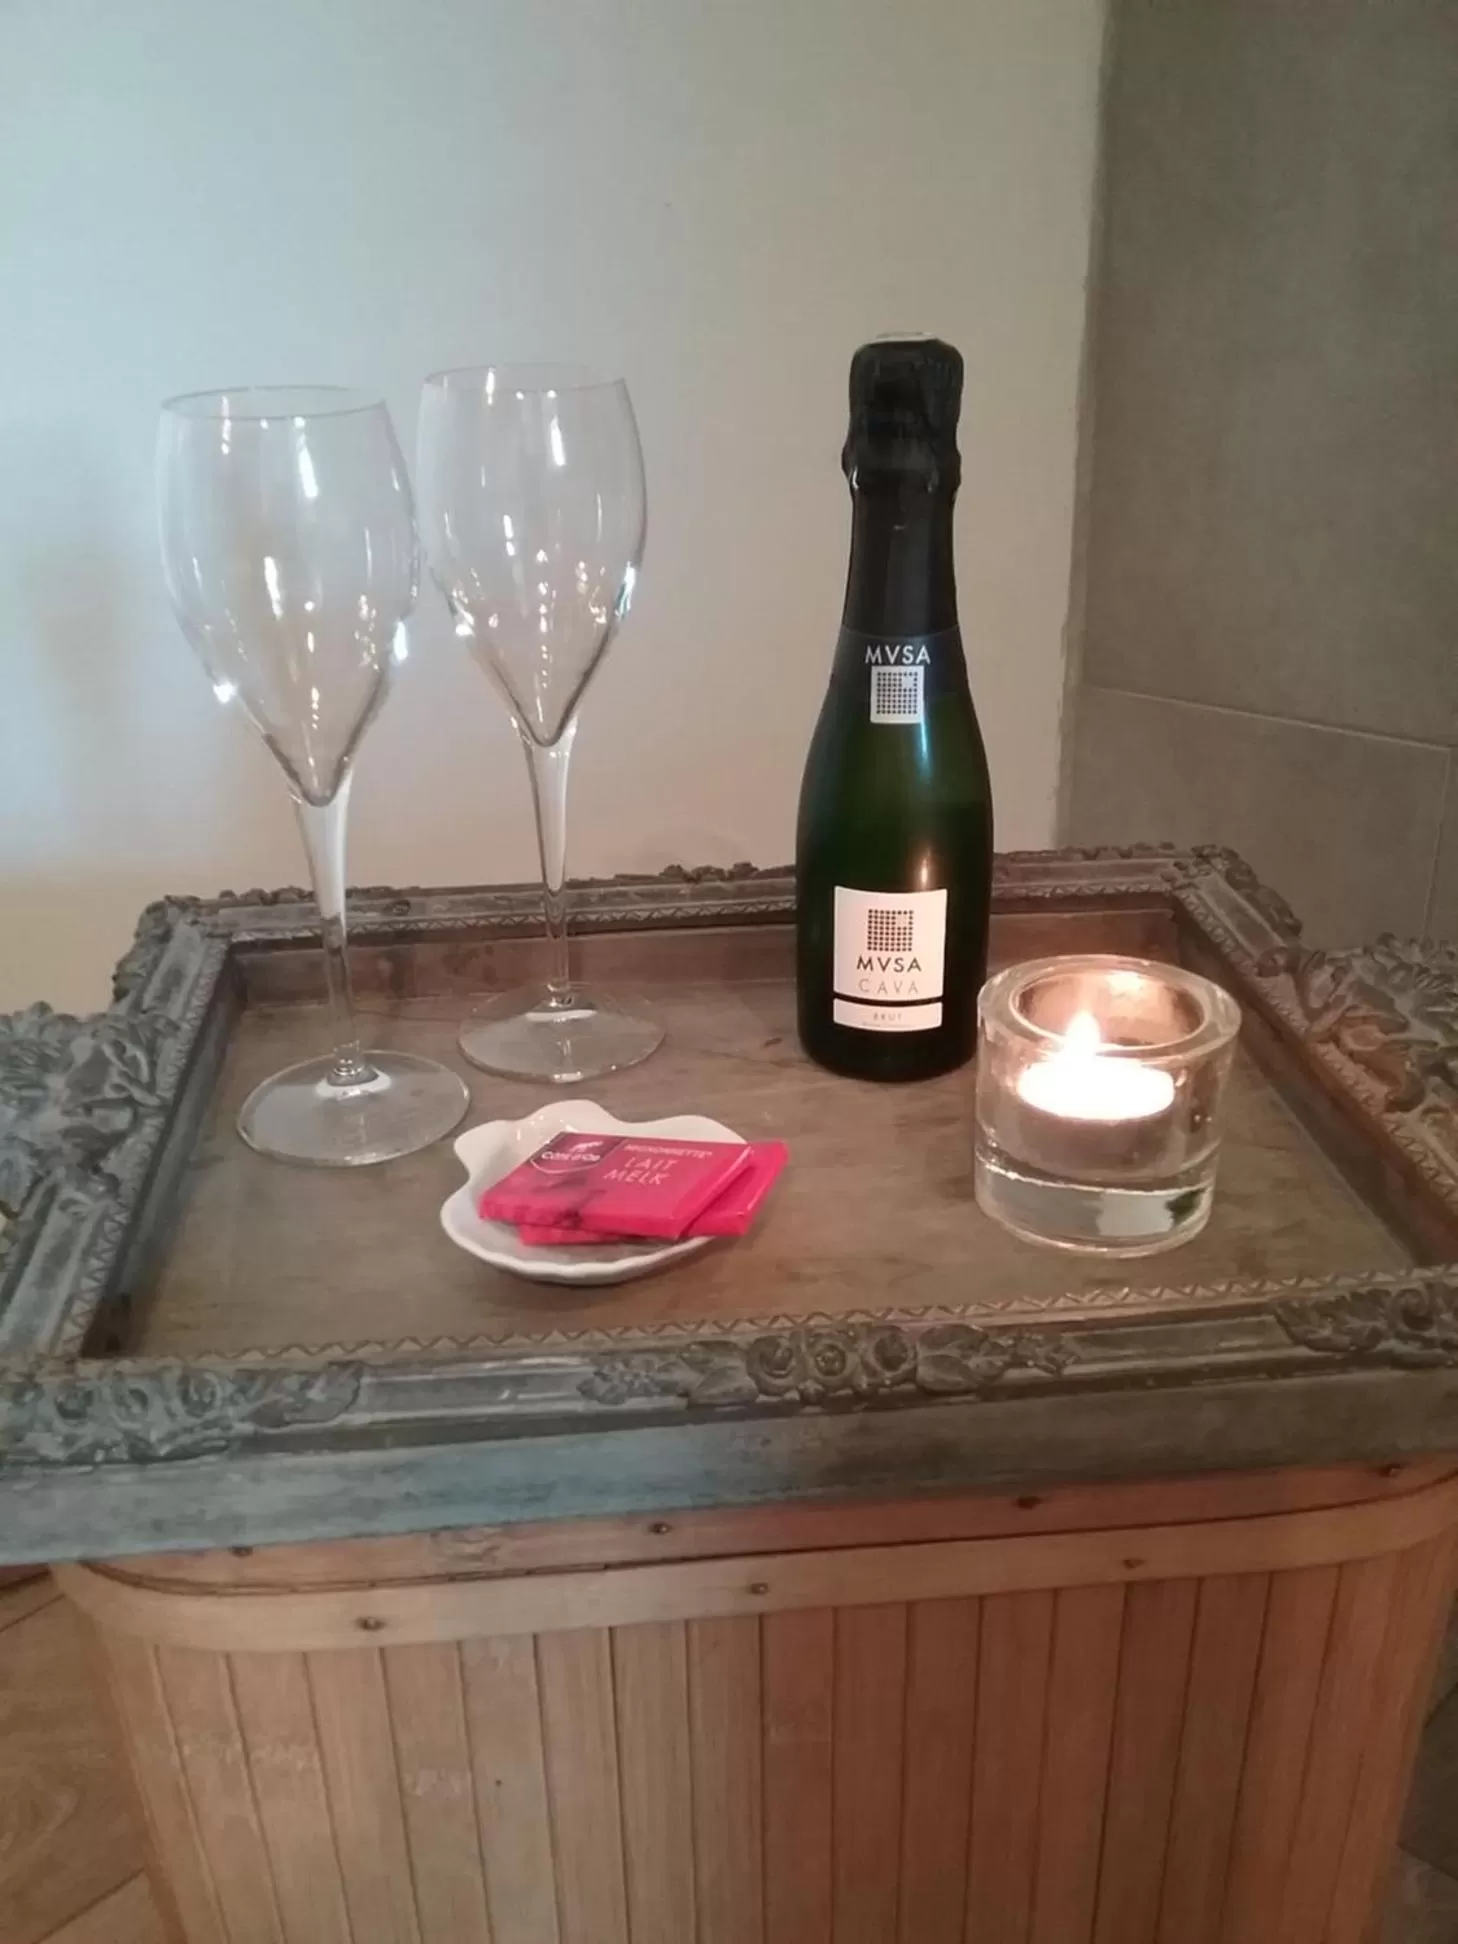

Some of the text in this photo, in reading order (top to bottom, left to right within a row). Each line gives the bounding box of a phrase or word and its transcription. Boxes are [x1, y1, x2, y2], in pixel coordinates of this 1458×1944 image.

[865, 644, 931, 665] MVSA
[856, 956, 922, 973] MVSA
[858, 978, 919, 995] CAVA
[624, 1157, 677, 1171] LAIT
[603, 1168, 671, 1185] MELK
